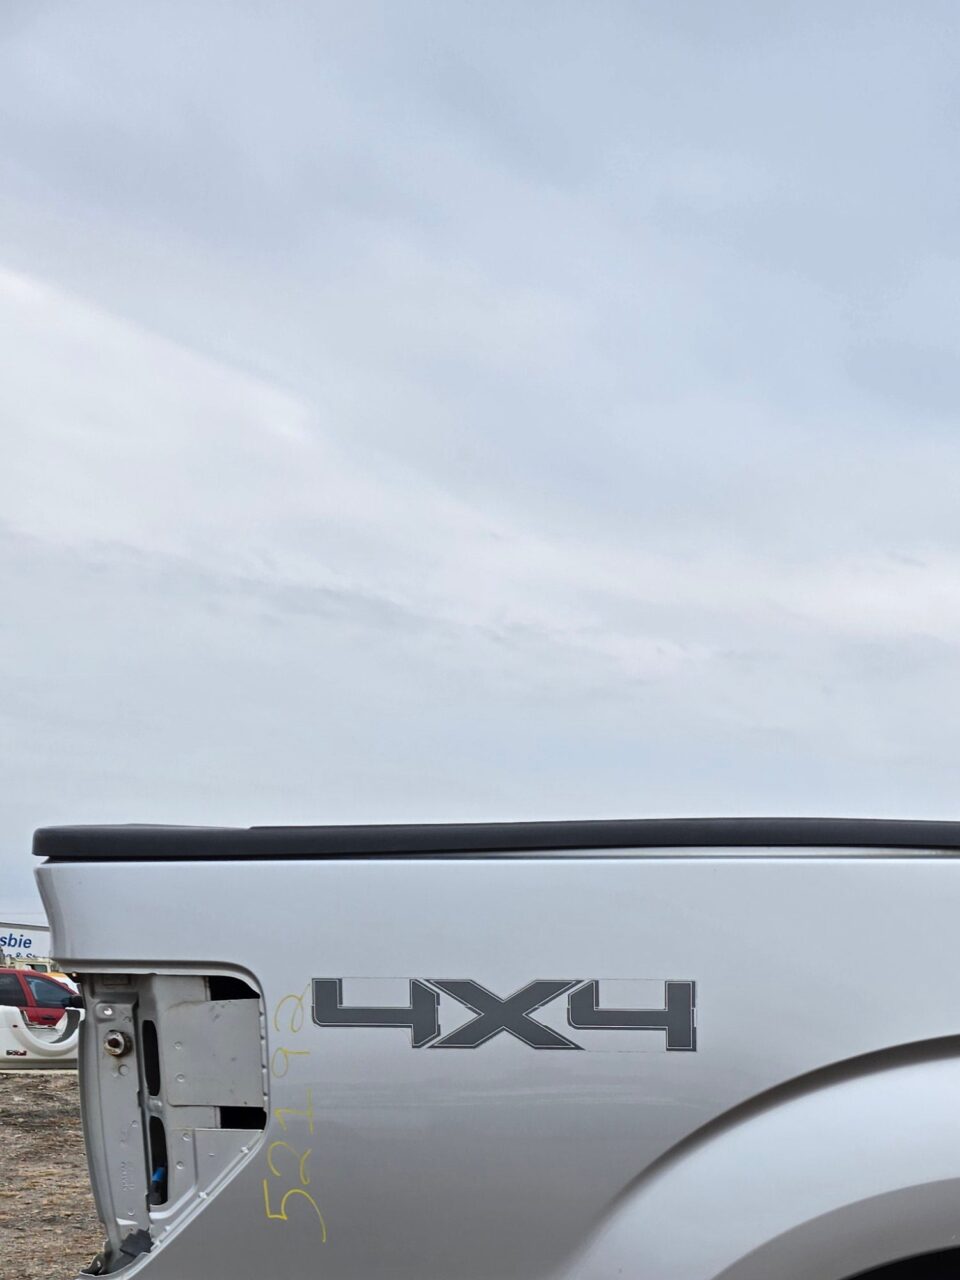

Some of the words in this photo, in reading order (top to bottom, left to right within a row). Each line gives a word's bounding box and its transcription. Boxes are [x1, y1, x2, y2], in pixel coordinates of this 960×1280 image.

[0, 933, 32, 949] sbie
[311, 977, 697, 1051] 4X4
[263, 984, 327, 1243] 52192
